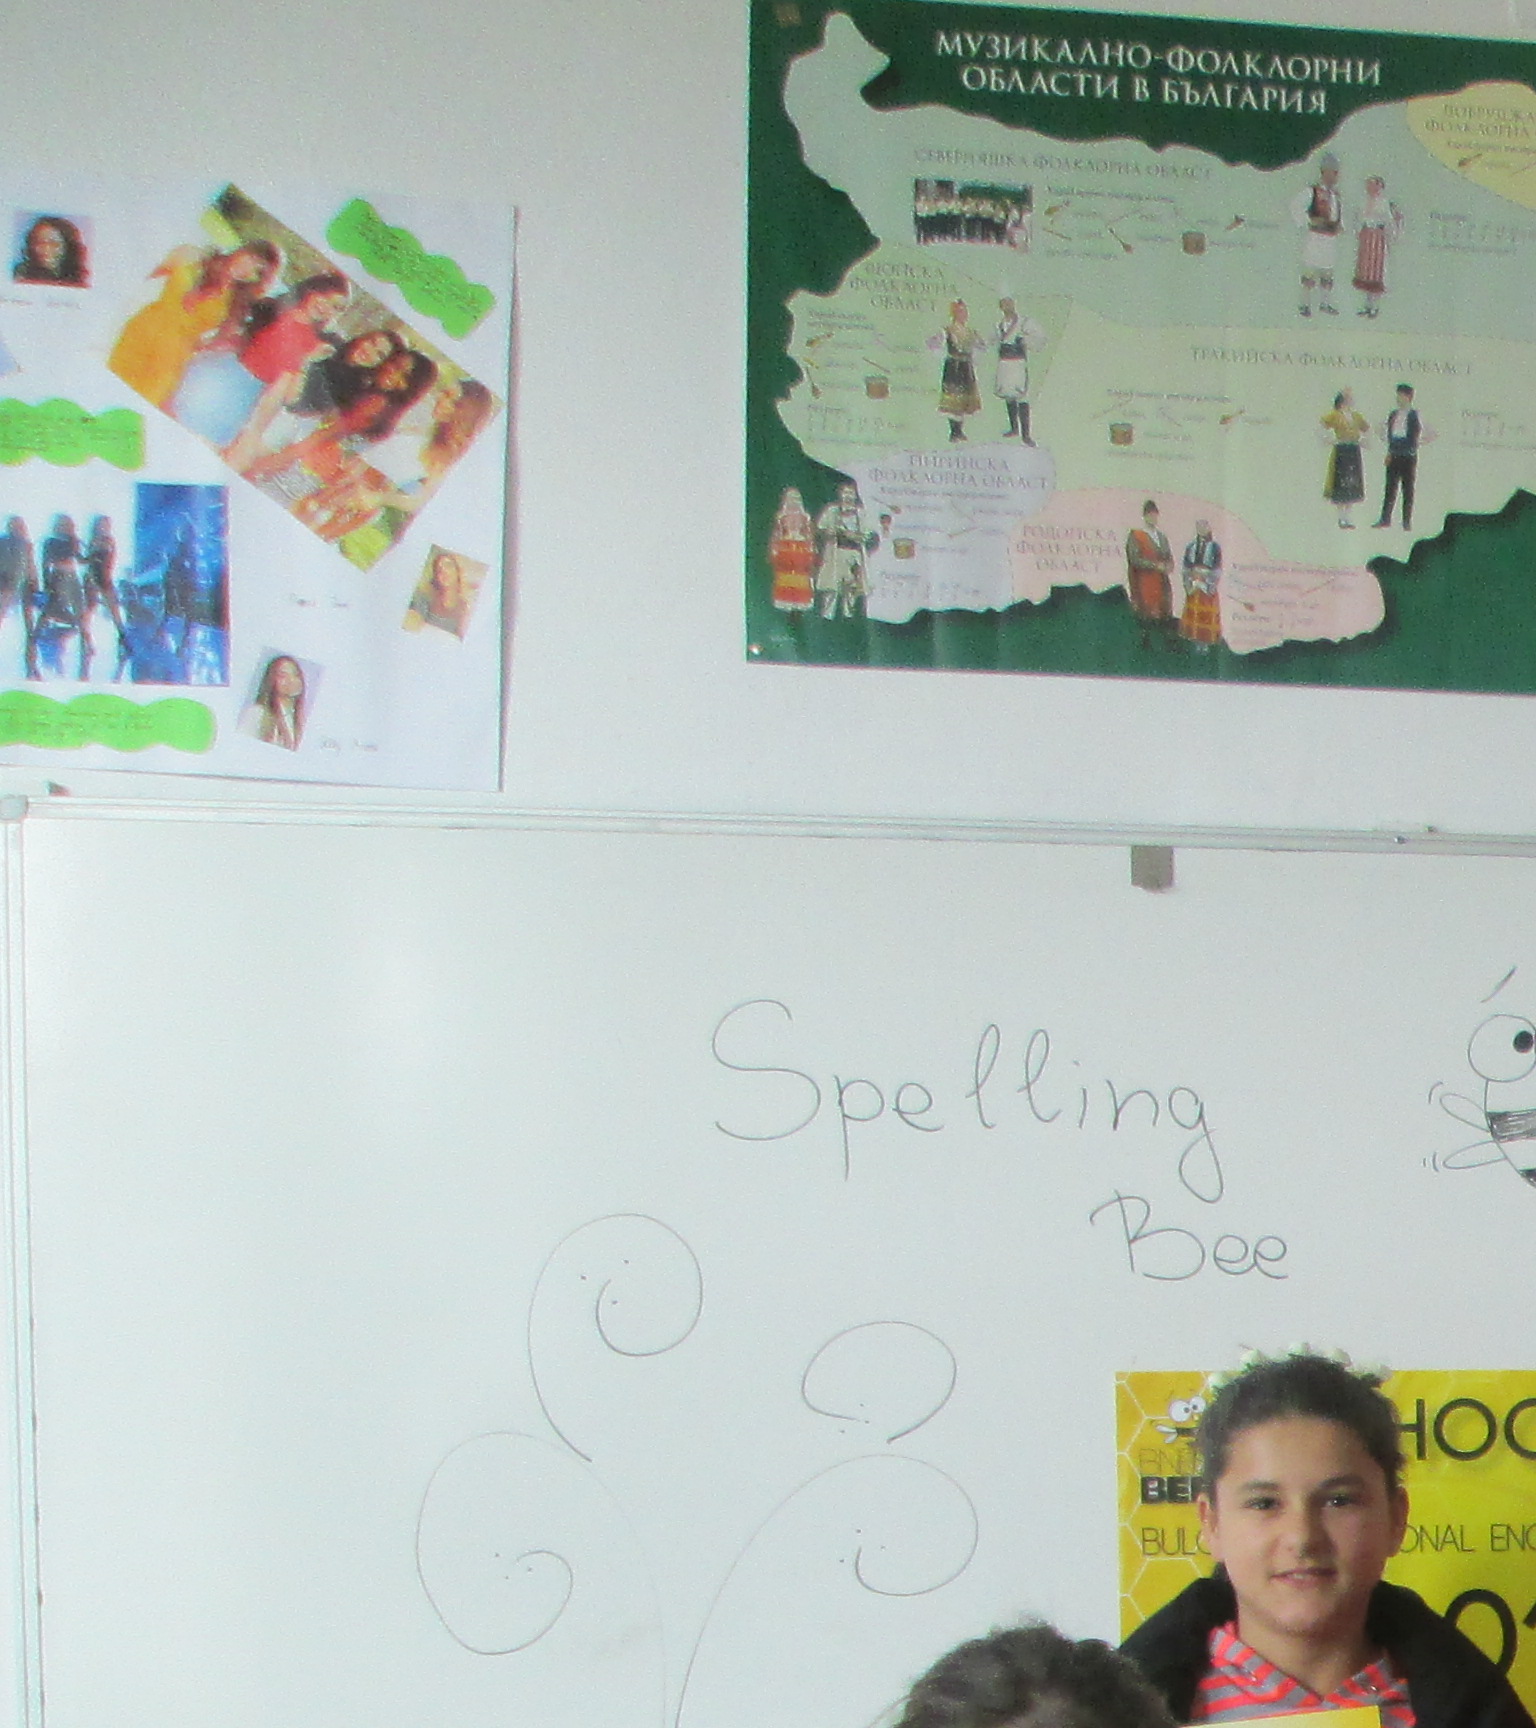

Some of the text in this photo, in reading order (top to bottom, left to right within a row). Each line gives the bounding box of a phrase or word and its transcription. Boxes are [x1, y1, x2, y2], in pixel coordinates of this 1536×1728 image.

[935, 30, 1382, 87] МУЗИКАЛНО-ФОЛКЛОРНИ
[961, 65, 1328, 115] ОБЛАСТИ В БЪЛГАРИЯ
[712, 999, 1224, 1203] Spelling
[1089, 1190, 1288, 1280] Bee
